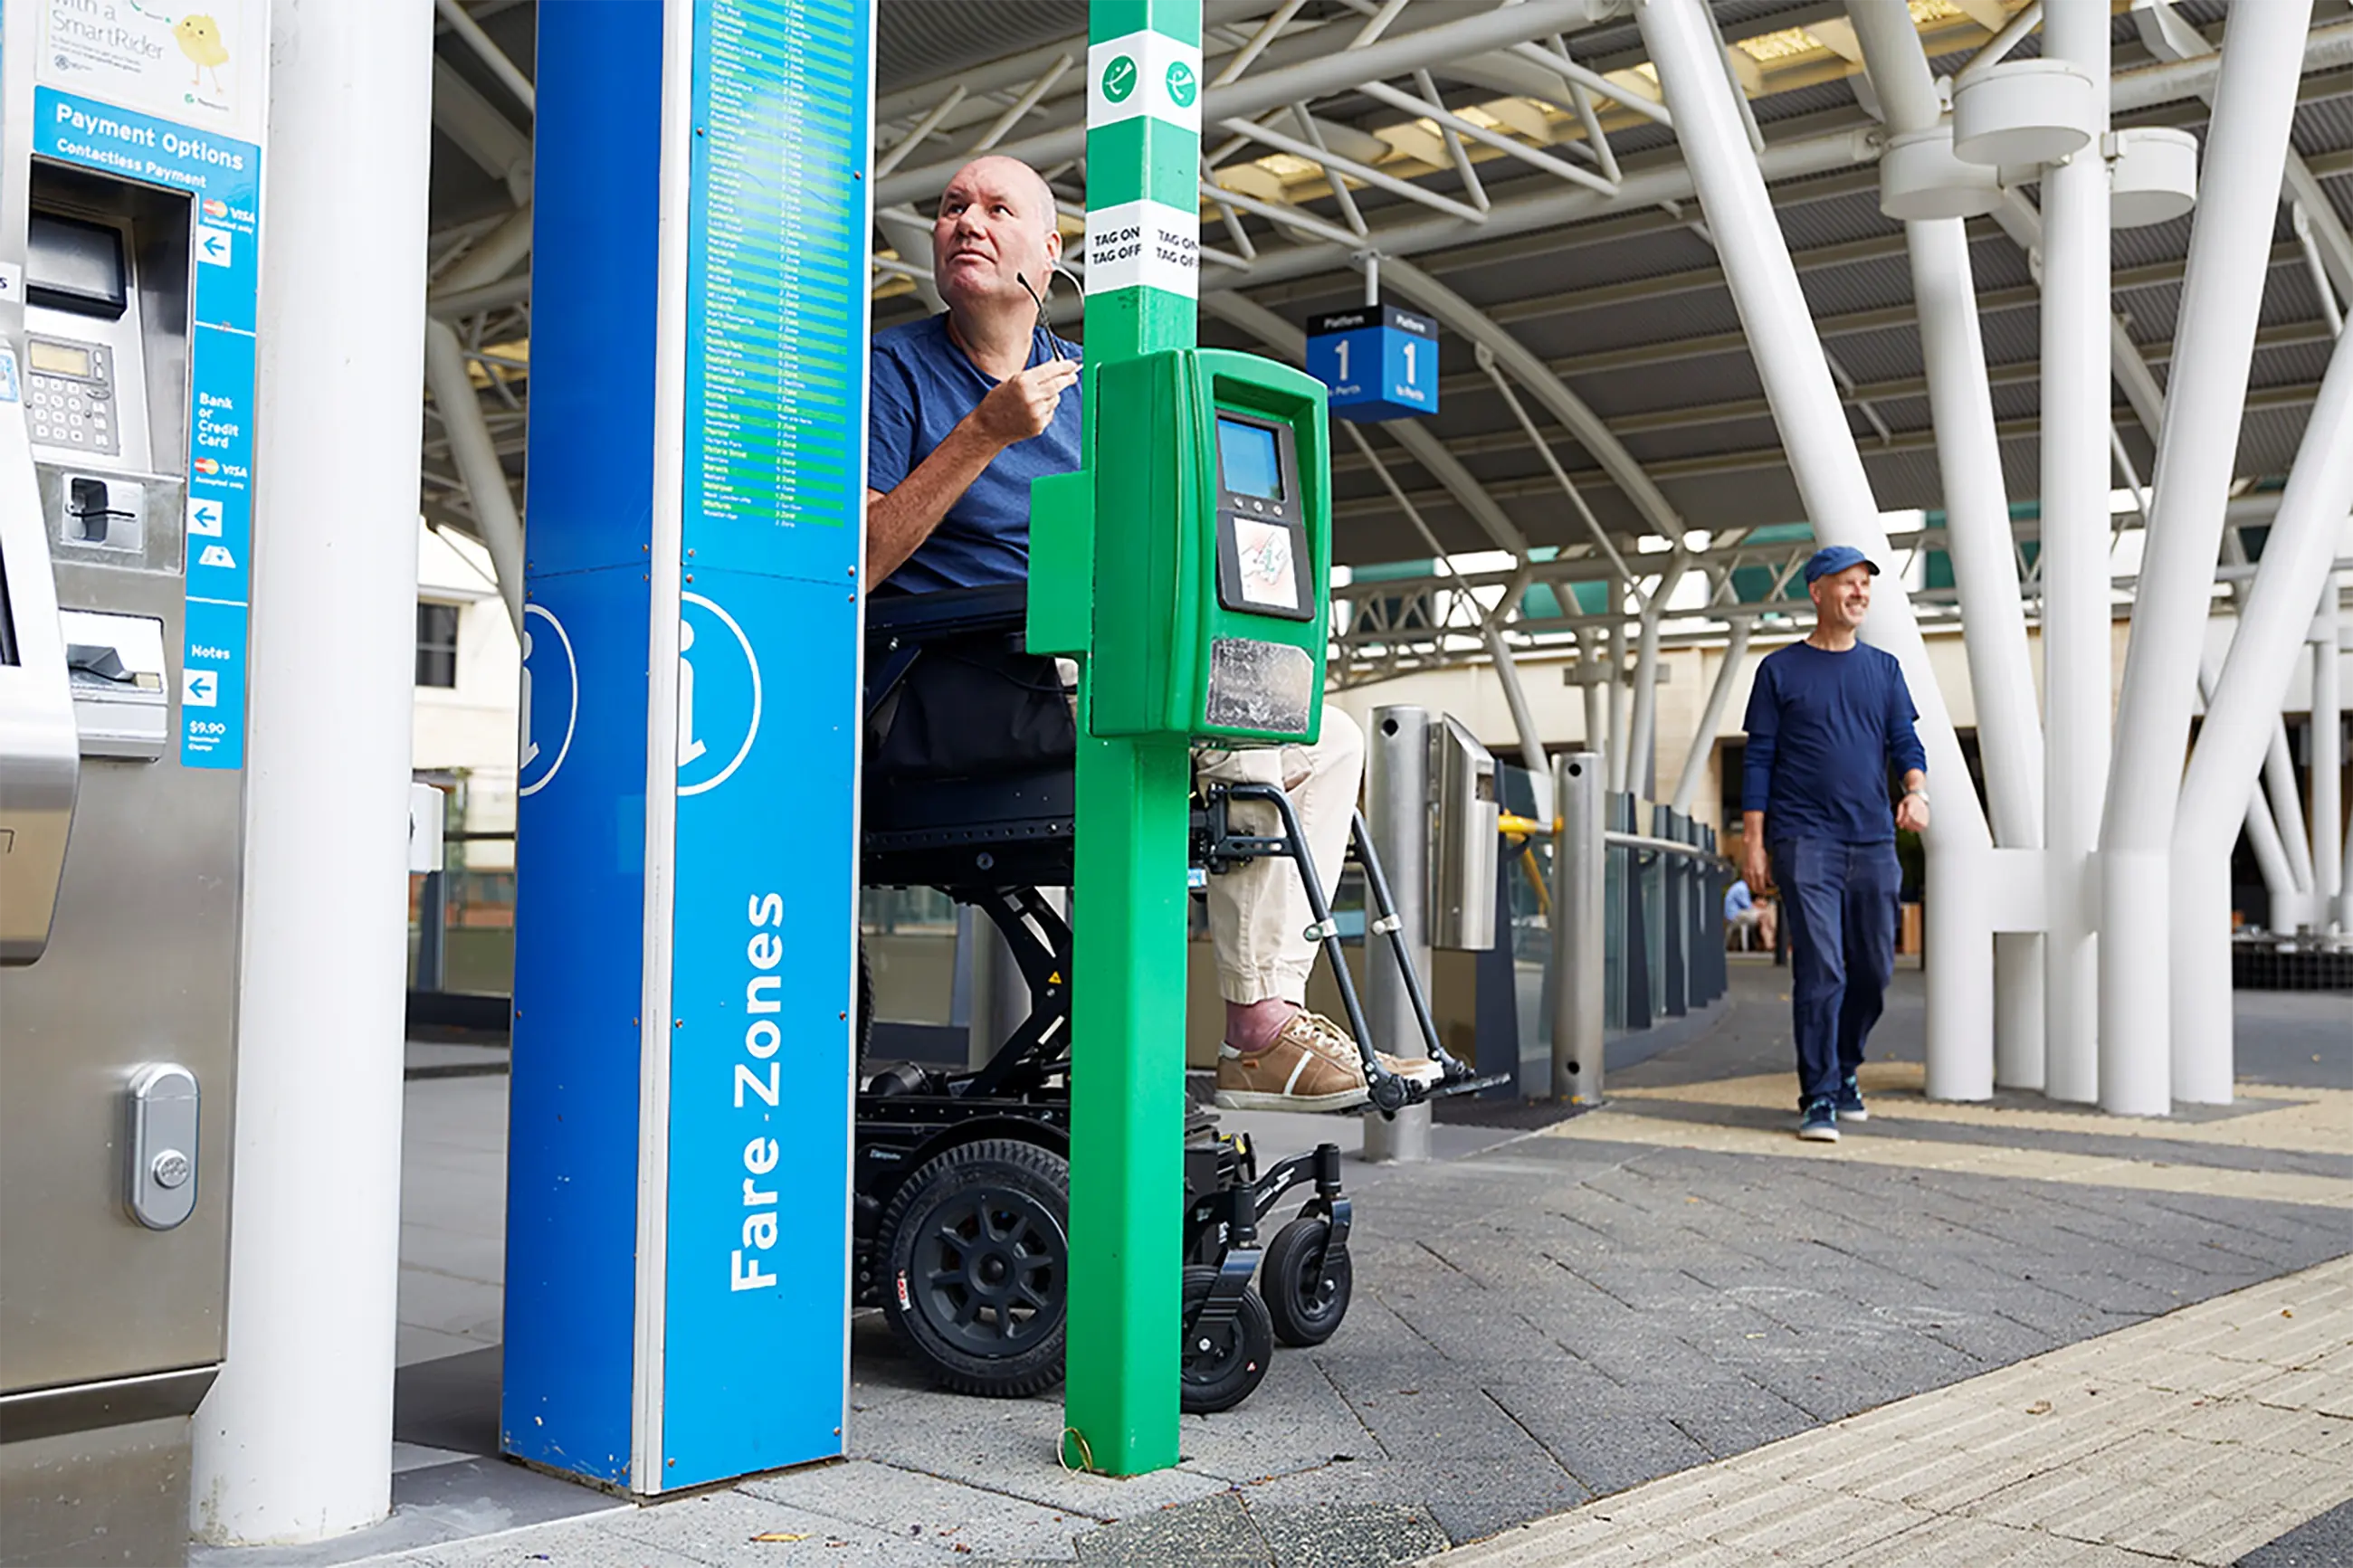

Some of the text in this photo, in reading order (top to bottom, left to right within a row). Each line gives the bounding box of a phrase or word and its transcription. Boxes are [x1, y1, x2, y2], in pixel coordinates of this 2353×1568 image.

[53, 0, 98, 14] th
[52, 9, 164, 59] SmartRider
[56, 103, 244, 171] Payment Options
[56, 138, 207, 188] Contactless Payment
[1094, 226, 1140, 247] TAG ON
[1157, 229, 1180, 246] TAG
[1092, 243, 1142, 265] TAG OFF
[1156, 247, 1177, 264] TAG
[1334, 339, 1349, 382] 1
[1403, 341, 1416, 385] 1
[199, 392, 233, 410] Bank
[198, 407, 214, 419] or
[197, 419, 239, 437] Credit
[197, 432, 229, 449] Card
[221, 463, 248, 478] VISA
[191, 643, 230, 660] Notes
[189, 720, 226, 735] $9.90
[731, 892, 784, 1292] Fare Zones
